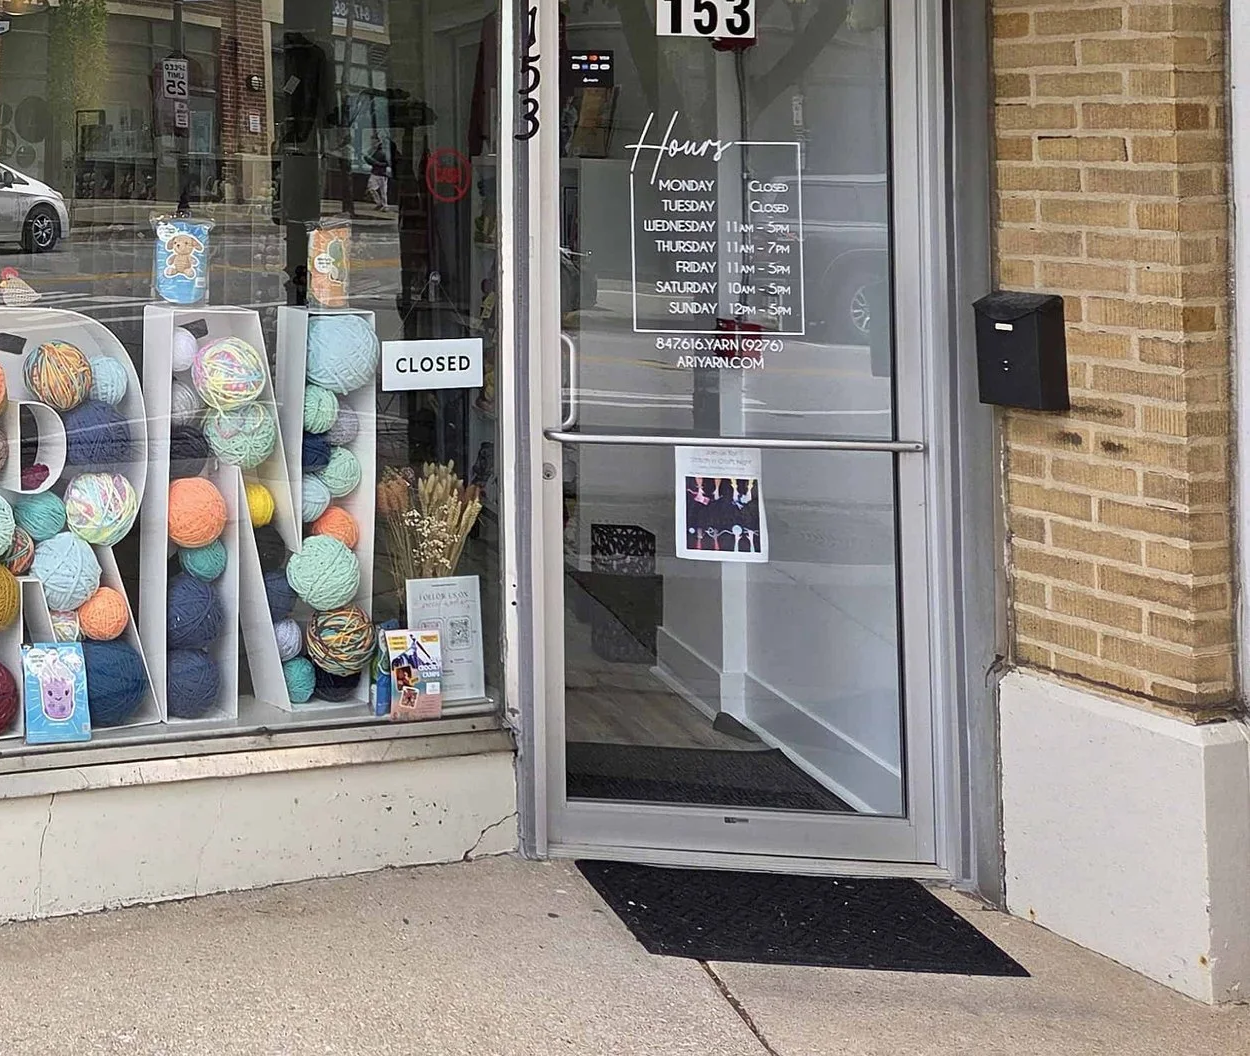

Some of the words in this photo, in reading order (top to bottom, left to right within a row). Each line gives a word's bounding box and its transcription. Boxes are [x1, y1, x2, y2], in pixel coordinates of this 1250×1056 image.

[514, 6, 541, 141] 153
[624, 110, 732, 185] Hours
[658, 179, 715, 192] MONDAY
[661, 199, 715, 212] TUESDAY
[643, 219, 716, 232] WEDNESDAY
[655, 240, 716, 253] THURSDAY
[675, 261, 717, 274] FRIDAY
[655, 281, 718, 294] SATURDAY
[669, 302, 718, 315] SUNDAY
[656, 337, 740, 351] 847.616.YARN
[741, 338, 784, 353] (9276)
[395, 355, 471, 374] CLOSED
[676, 356, 765, 370] ARIYARN.COM
